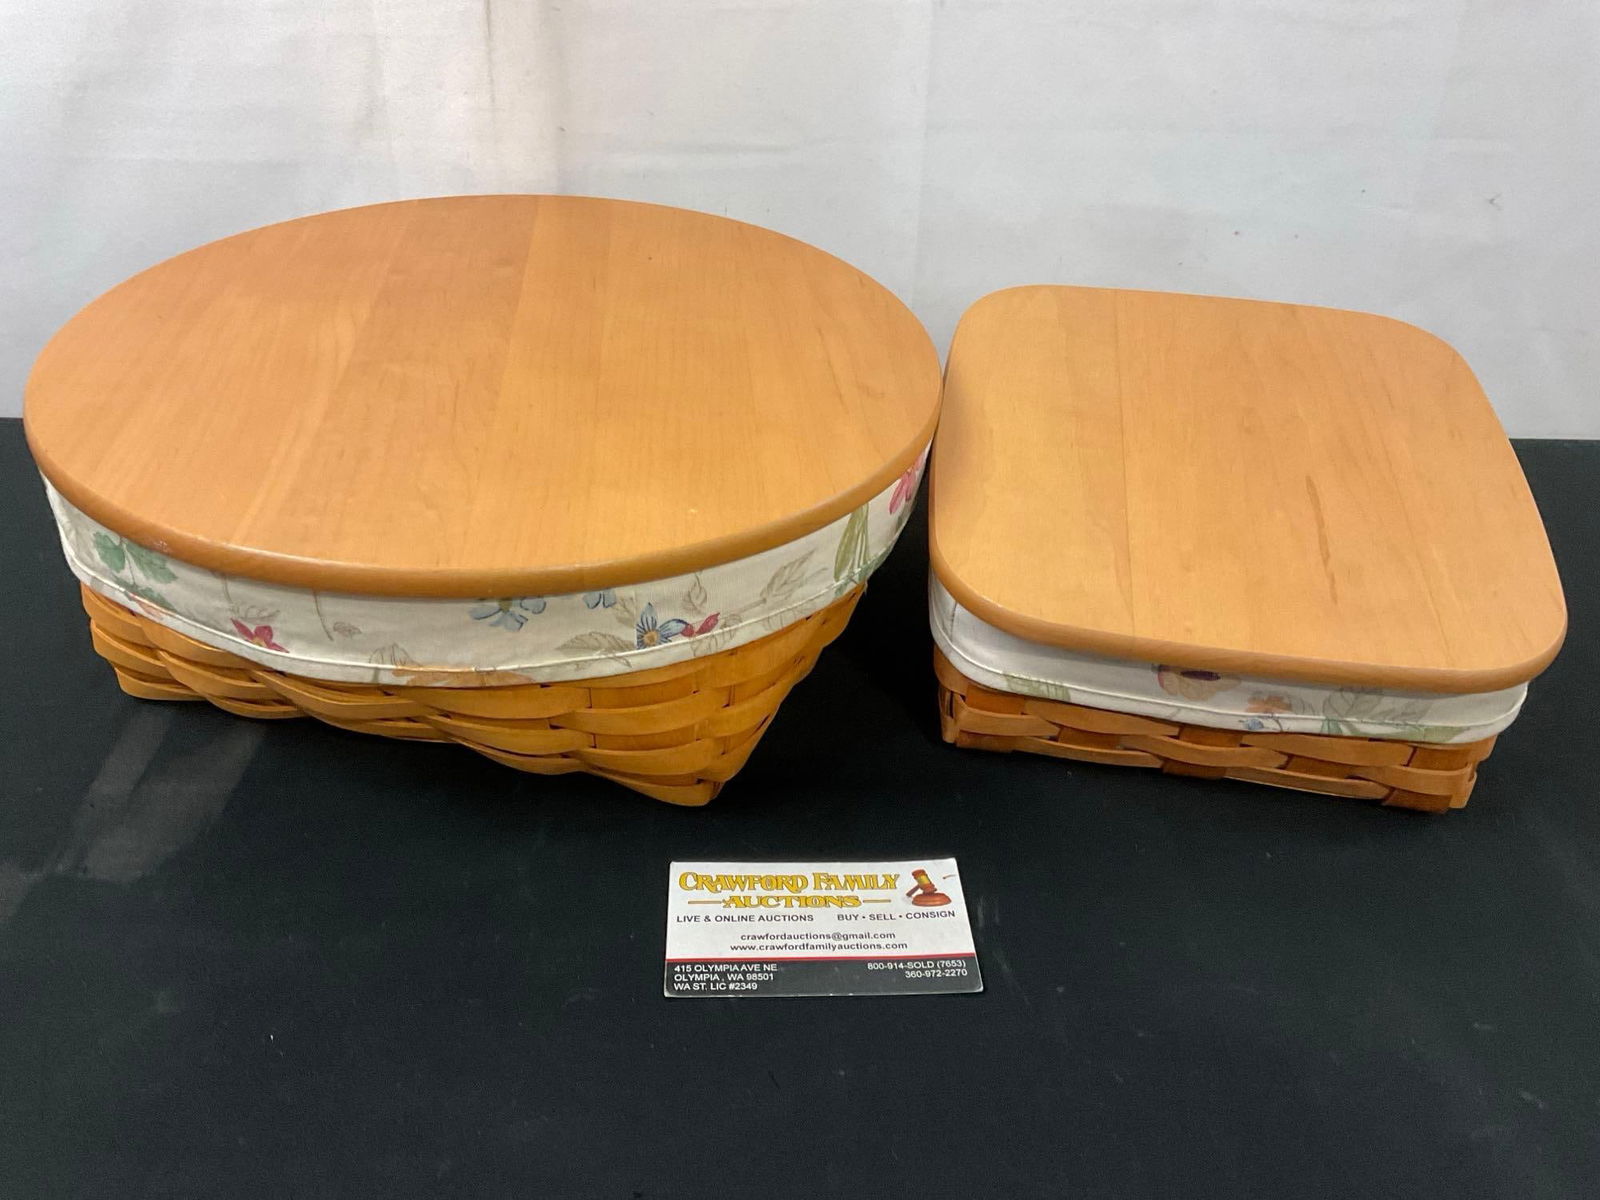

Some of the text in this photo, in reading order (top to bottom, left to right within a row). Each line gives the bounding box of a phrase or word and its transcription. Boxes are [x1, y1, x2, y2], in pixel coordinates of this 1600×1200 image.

[678, 871, 900, 894] CRAWFORD FAMILY
[722, 894, 862, 908] AUCTIONS
[676, 915, 700, 923] LIVE
[714, 914, 755, 922] ONLINE
[757, 914, 814, 922] AUCTIONS
[837, 910, 956, 921] BUY SELL CONSIGN
[740, 931, 896, 941] crawfordauctions@gmail.com
[730, 942, 908, 951] www.crawfordfamilyauctions.com
[673, 963, 778, 972] 415 OLYMPIA AVE NE
[867, 959, 966, 970] 800-914-SOLD (7653)
[727, 973, 744, 981] WA
[746, 972, 774, 981] 98501
[905, 968, 968, 979] 360-972-2270
[673, 982, 758, 991] WA ST. LIC #2349
